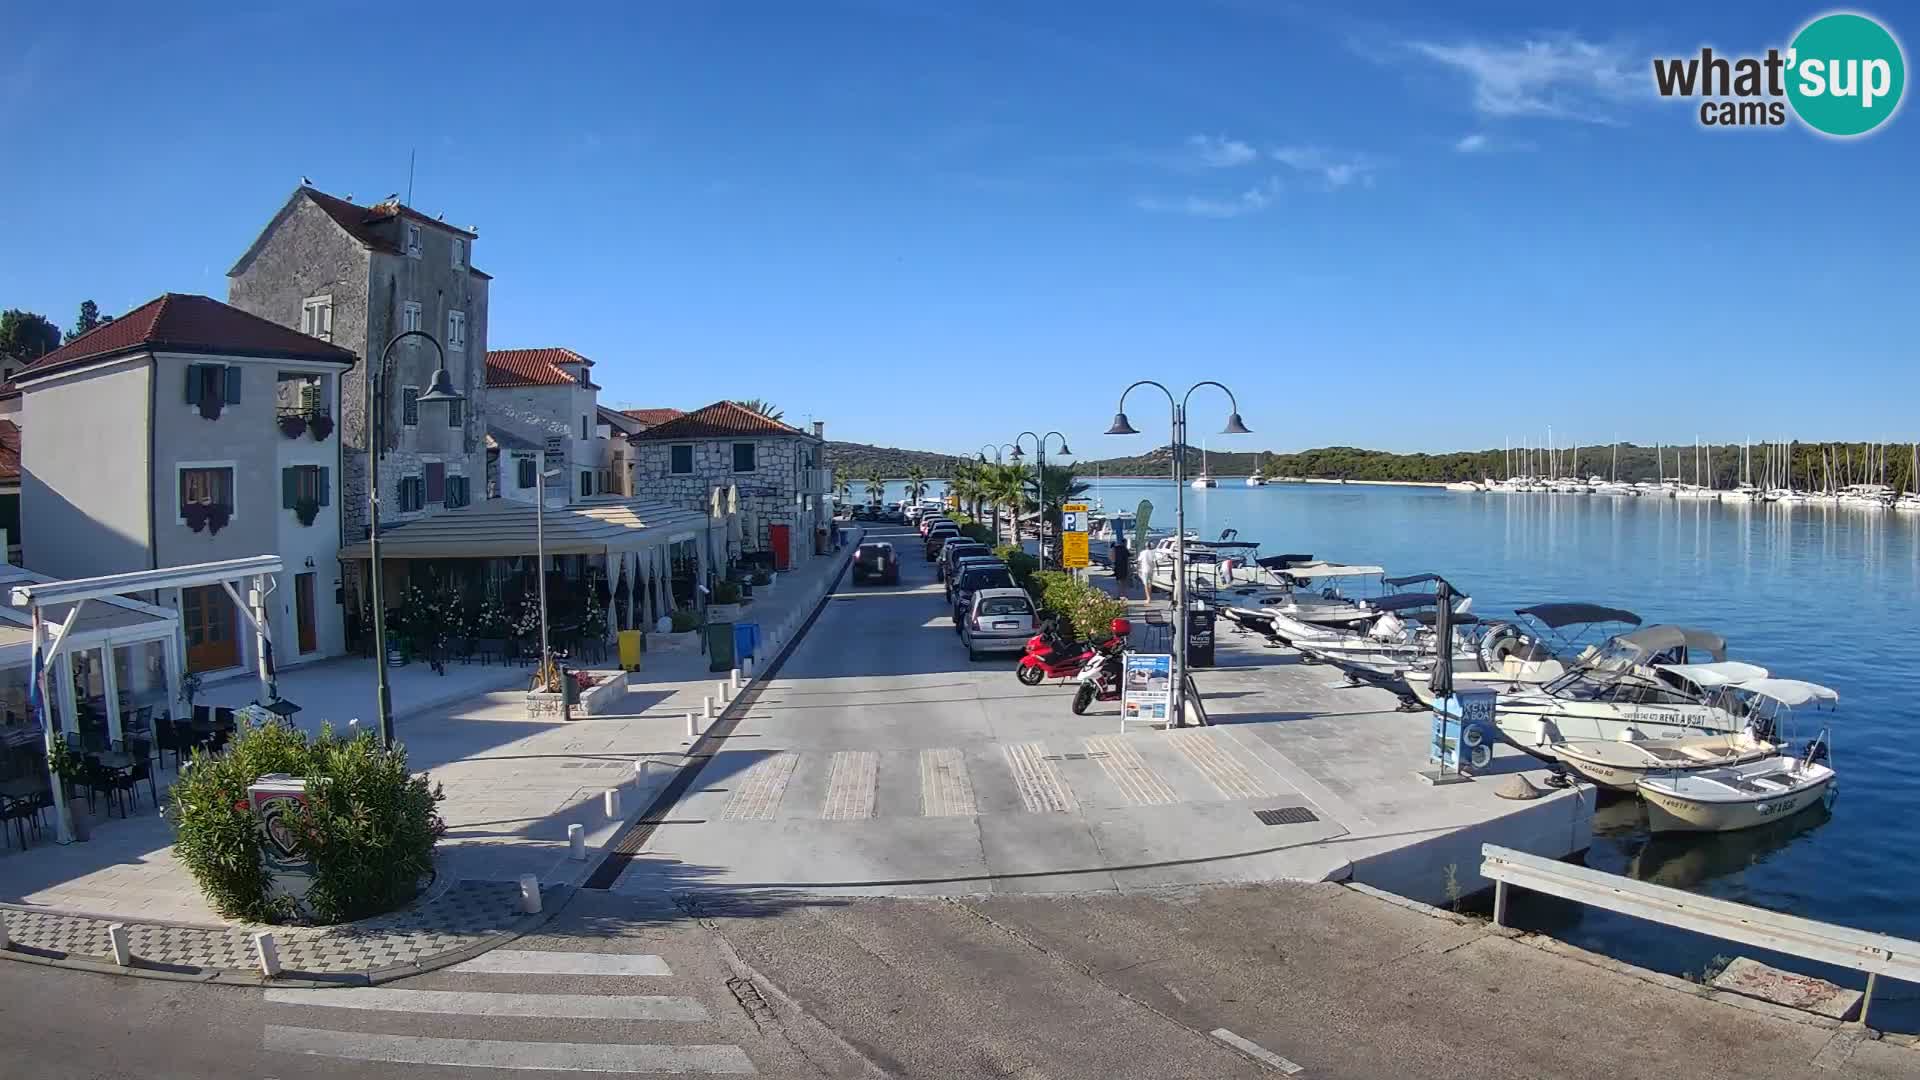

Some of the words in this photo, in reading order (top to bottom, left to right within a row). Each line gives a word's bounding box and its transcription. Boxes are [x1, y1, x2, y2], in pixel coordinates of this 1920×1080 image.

[1065, 513, 1075, 530] P
[1463, 702, 1493, 712] RENT
[1462, 712, 1469, 721] A
[1471, 712, 1493, 721] BOAT
[1659, 713, 1680, 723] RENT
[1680, 714, 1686, 723] A
[1687, 714, 1706, 726] BOAT
